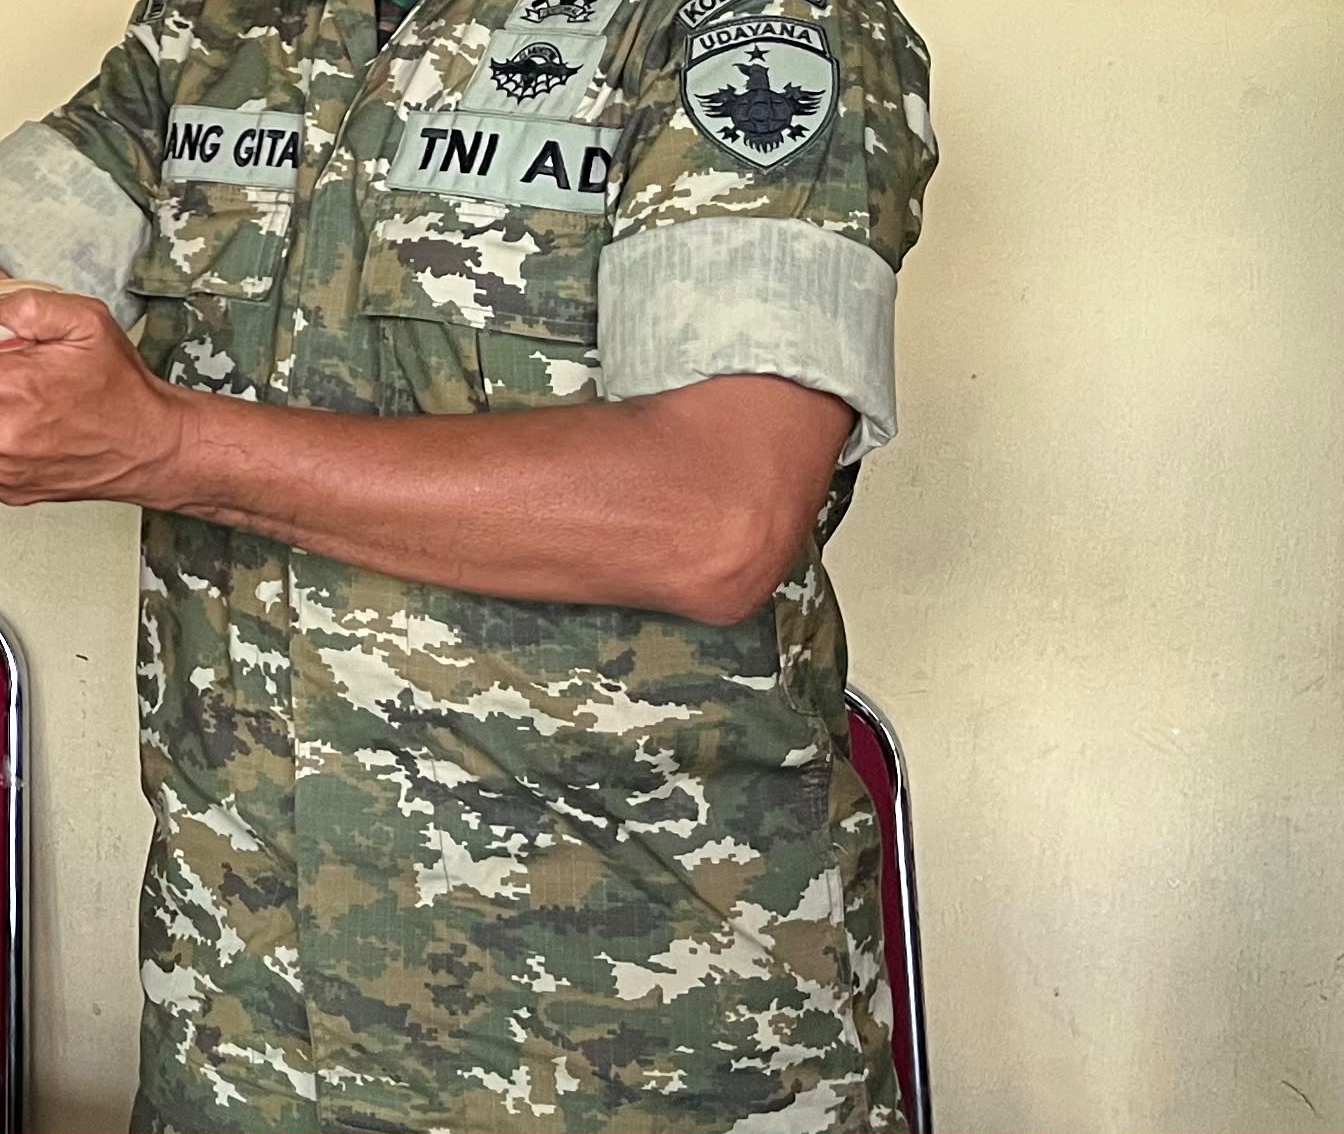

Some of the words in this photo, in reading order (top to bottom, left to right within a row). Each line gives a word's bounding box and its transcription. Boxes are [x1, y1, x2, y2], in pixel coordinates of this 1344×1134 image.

[699, 22, 812, 50] UDAYANA
[233, 128, 300, 169] GITA
[419, 127, 500, 177] TNI
[520, 140, 612, 194] AD
